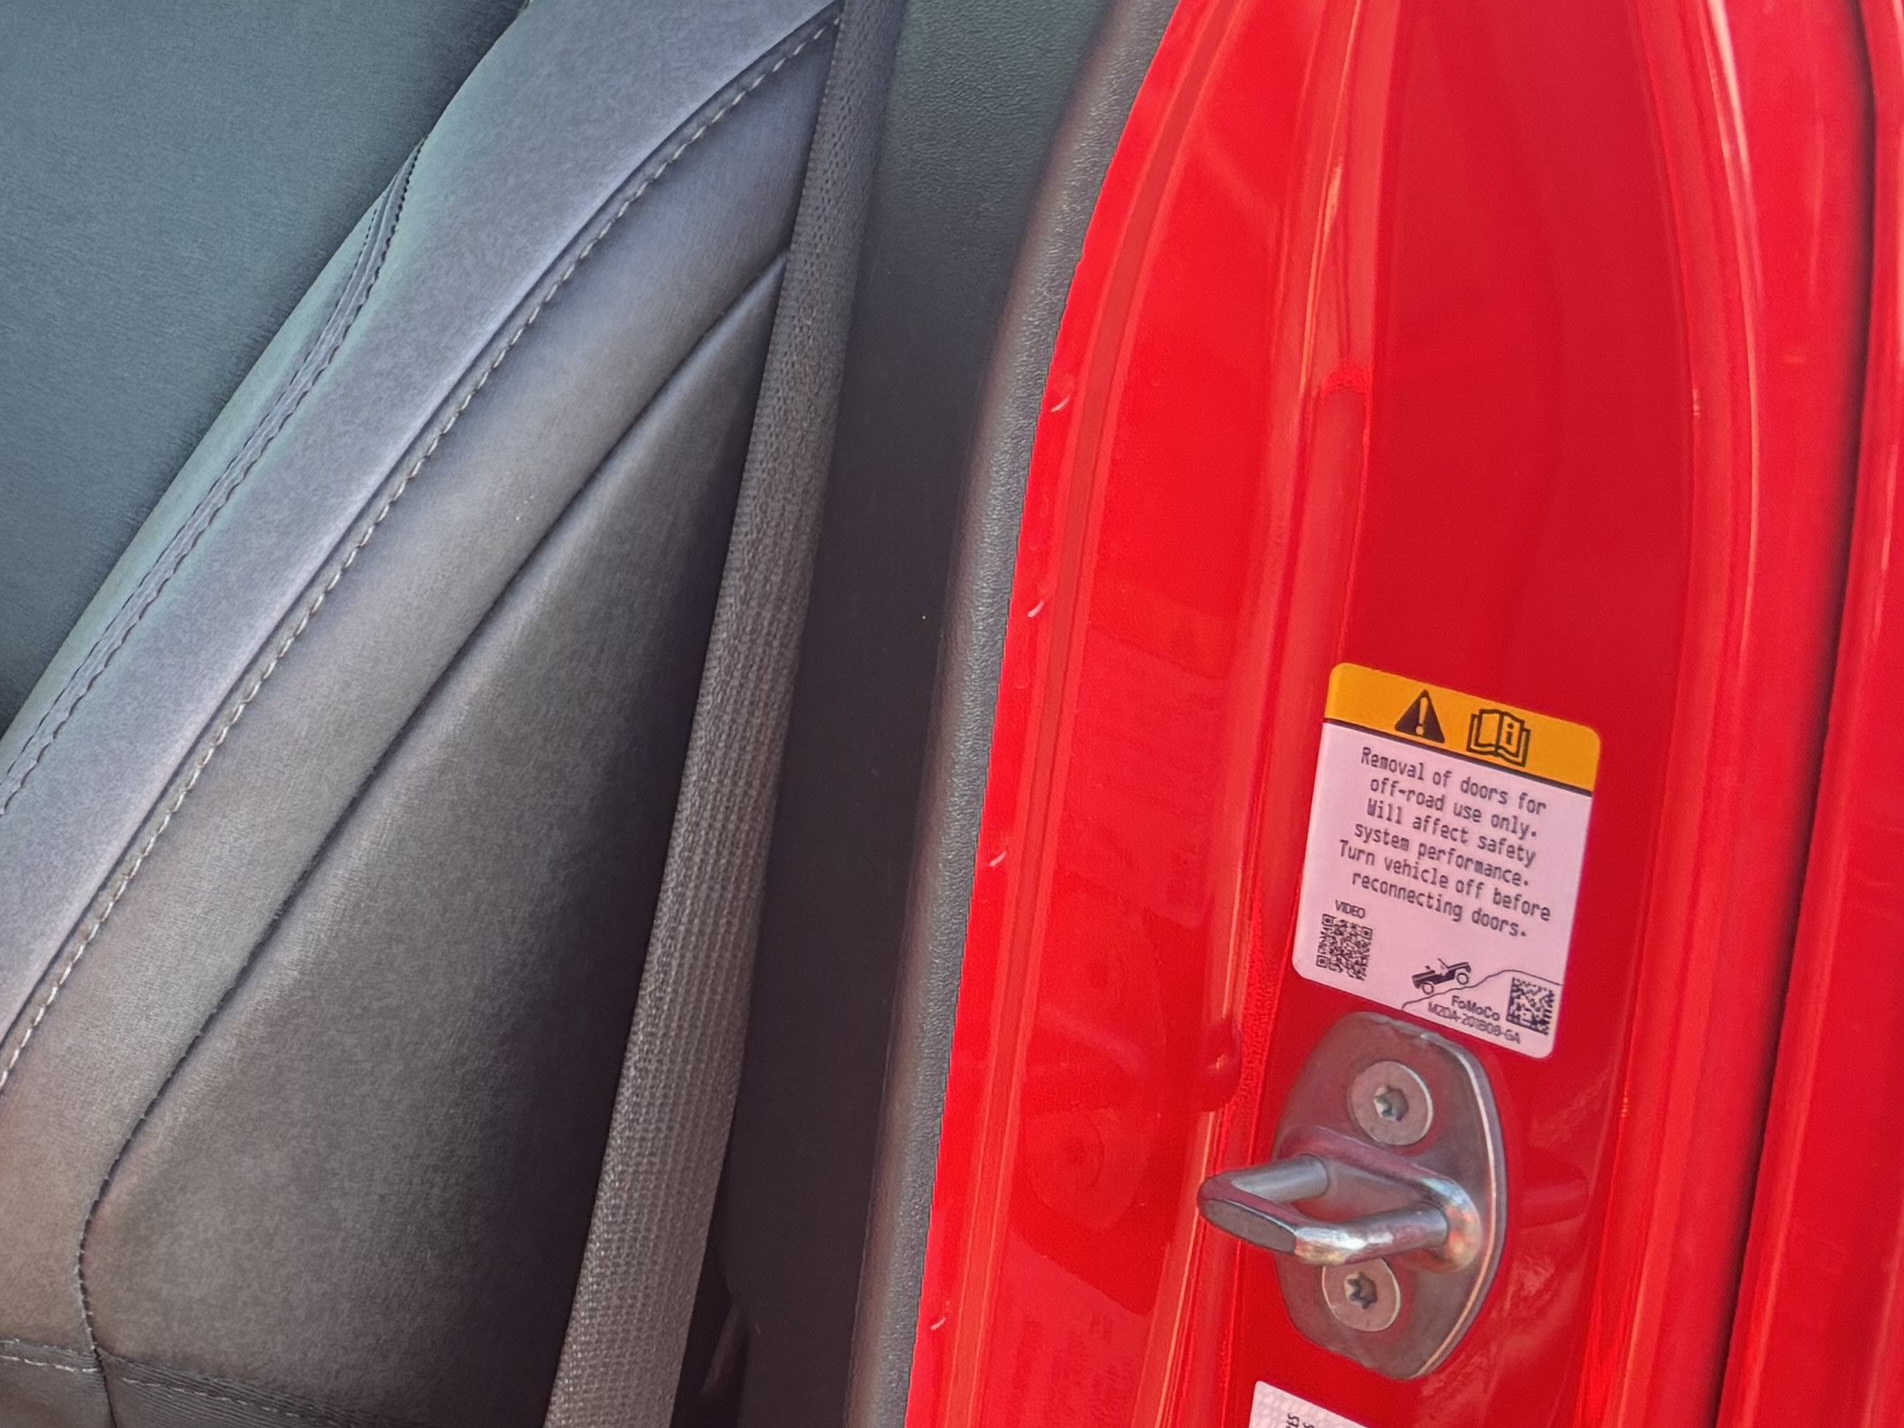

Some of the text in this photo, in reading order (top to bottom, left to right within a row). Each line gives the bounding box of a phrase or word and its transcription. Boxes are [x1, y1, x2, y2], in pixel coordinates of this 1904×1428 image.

[1360, 745, 1547, 816] Removal of doors for
[1369, 775, 1538, 841] off-road use only.
[1353, 821, 1529, 889] system performance.
[1366, 797, 1536, 868] Will affect safety
[1334, 899, 1366, 920] VIDEO
[1338, 839, 1551, 922] Turn vehicle off before
[1351, 870, 1527, 940] reconnecting doors.
[1450, 993, 1501, 1022] FoMoCo
